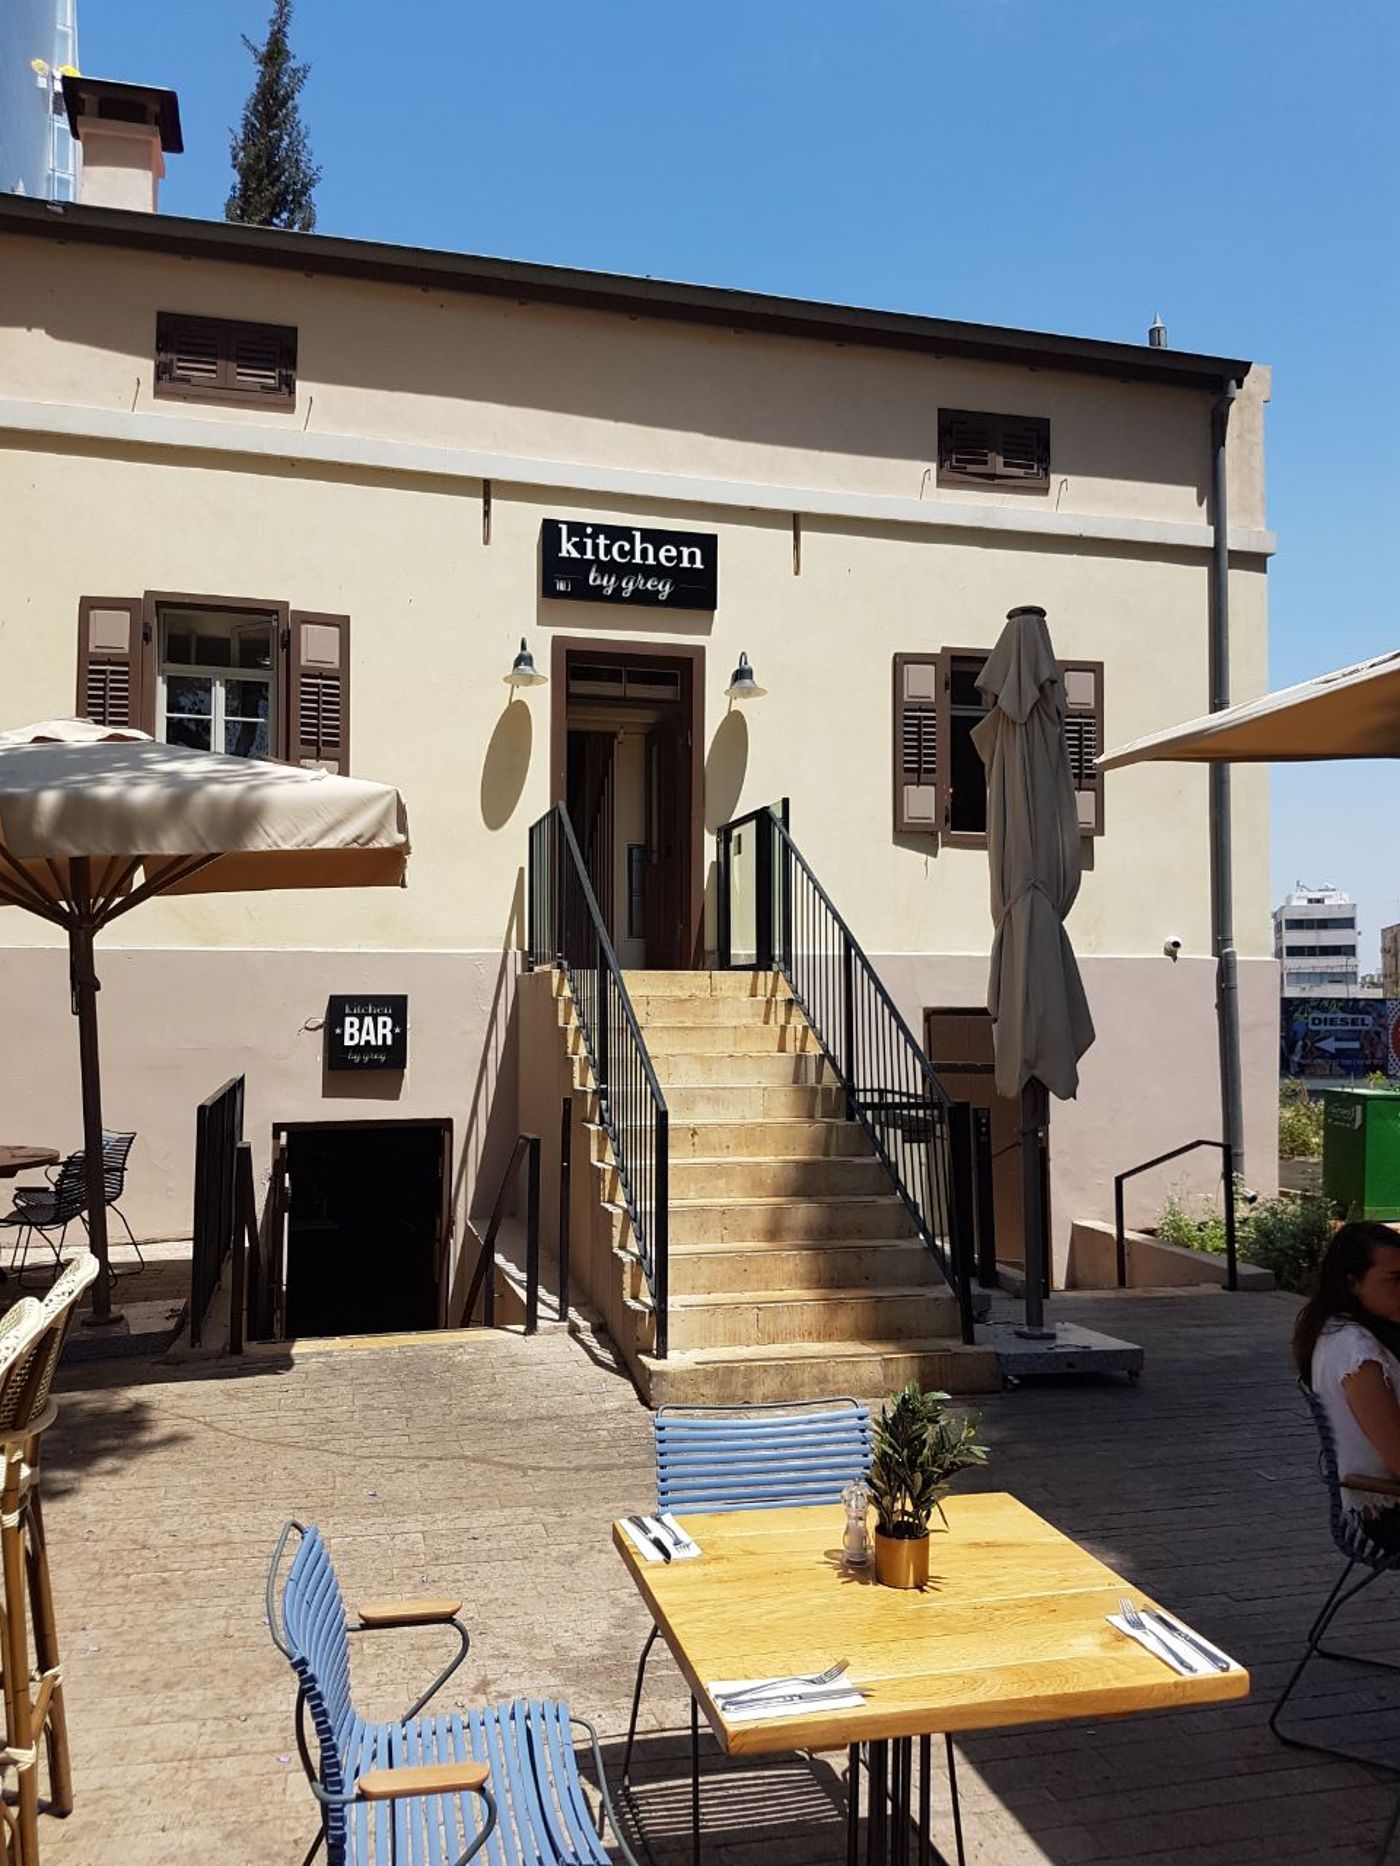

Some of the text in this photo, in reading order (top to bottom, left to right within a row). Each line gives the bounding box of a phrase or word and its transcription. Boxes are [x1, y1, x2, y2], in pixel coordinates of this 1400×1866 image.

[558, 524, 704, 569] kitchen
[588, 564, 675, 600] by greg
[345, 1003, 392, 1014] kitchen
[1311, 1016, 1370, 1027] DIESEL
[343, 1015, 393, 1046] BAR
